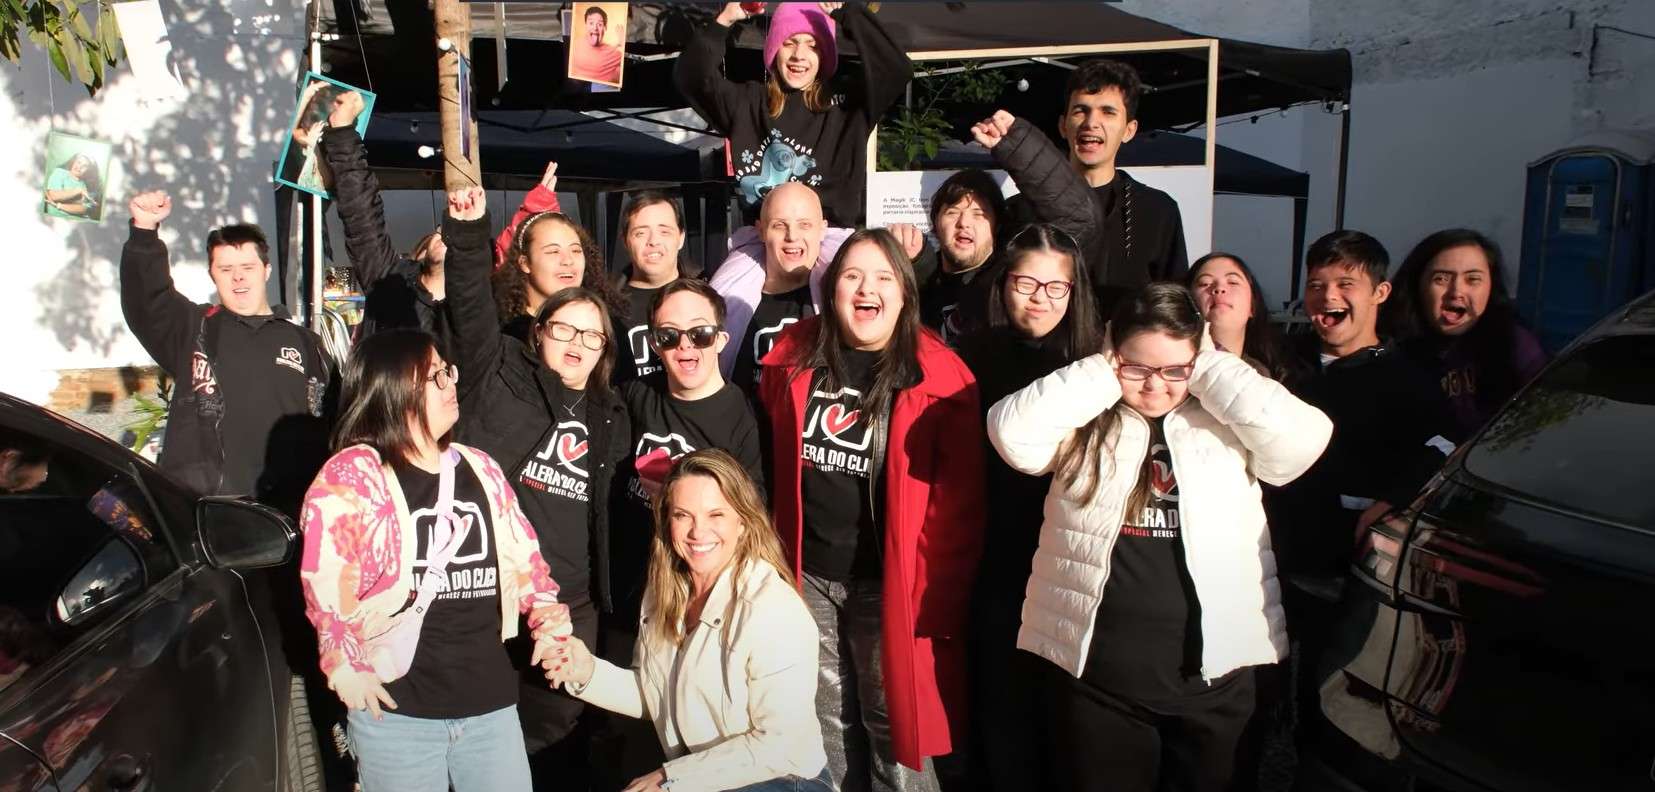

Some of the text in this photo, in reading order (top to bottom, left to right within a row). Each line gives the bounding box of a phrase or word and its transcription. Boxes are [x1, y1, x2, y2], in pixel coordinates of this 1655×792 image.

[784, 137, 813, 156] ALOHA
[745, 160, 761, 174] BAD
[801, 443, 825, 464] ERA
[827, 449, 846, 468] DO
[847, 454, 870, 473] CLI
[521, 460, 561, 487] ALERA
[1167, 508, 1179, 528] D
[451, 569, 472, 590] DO
